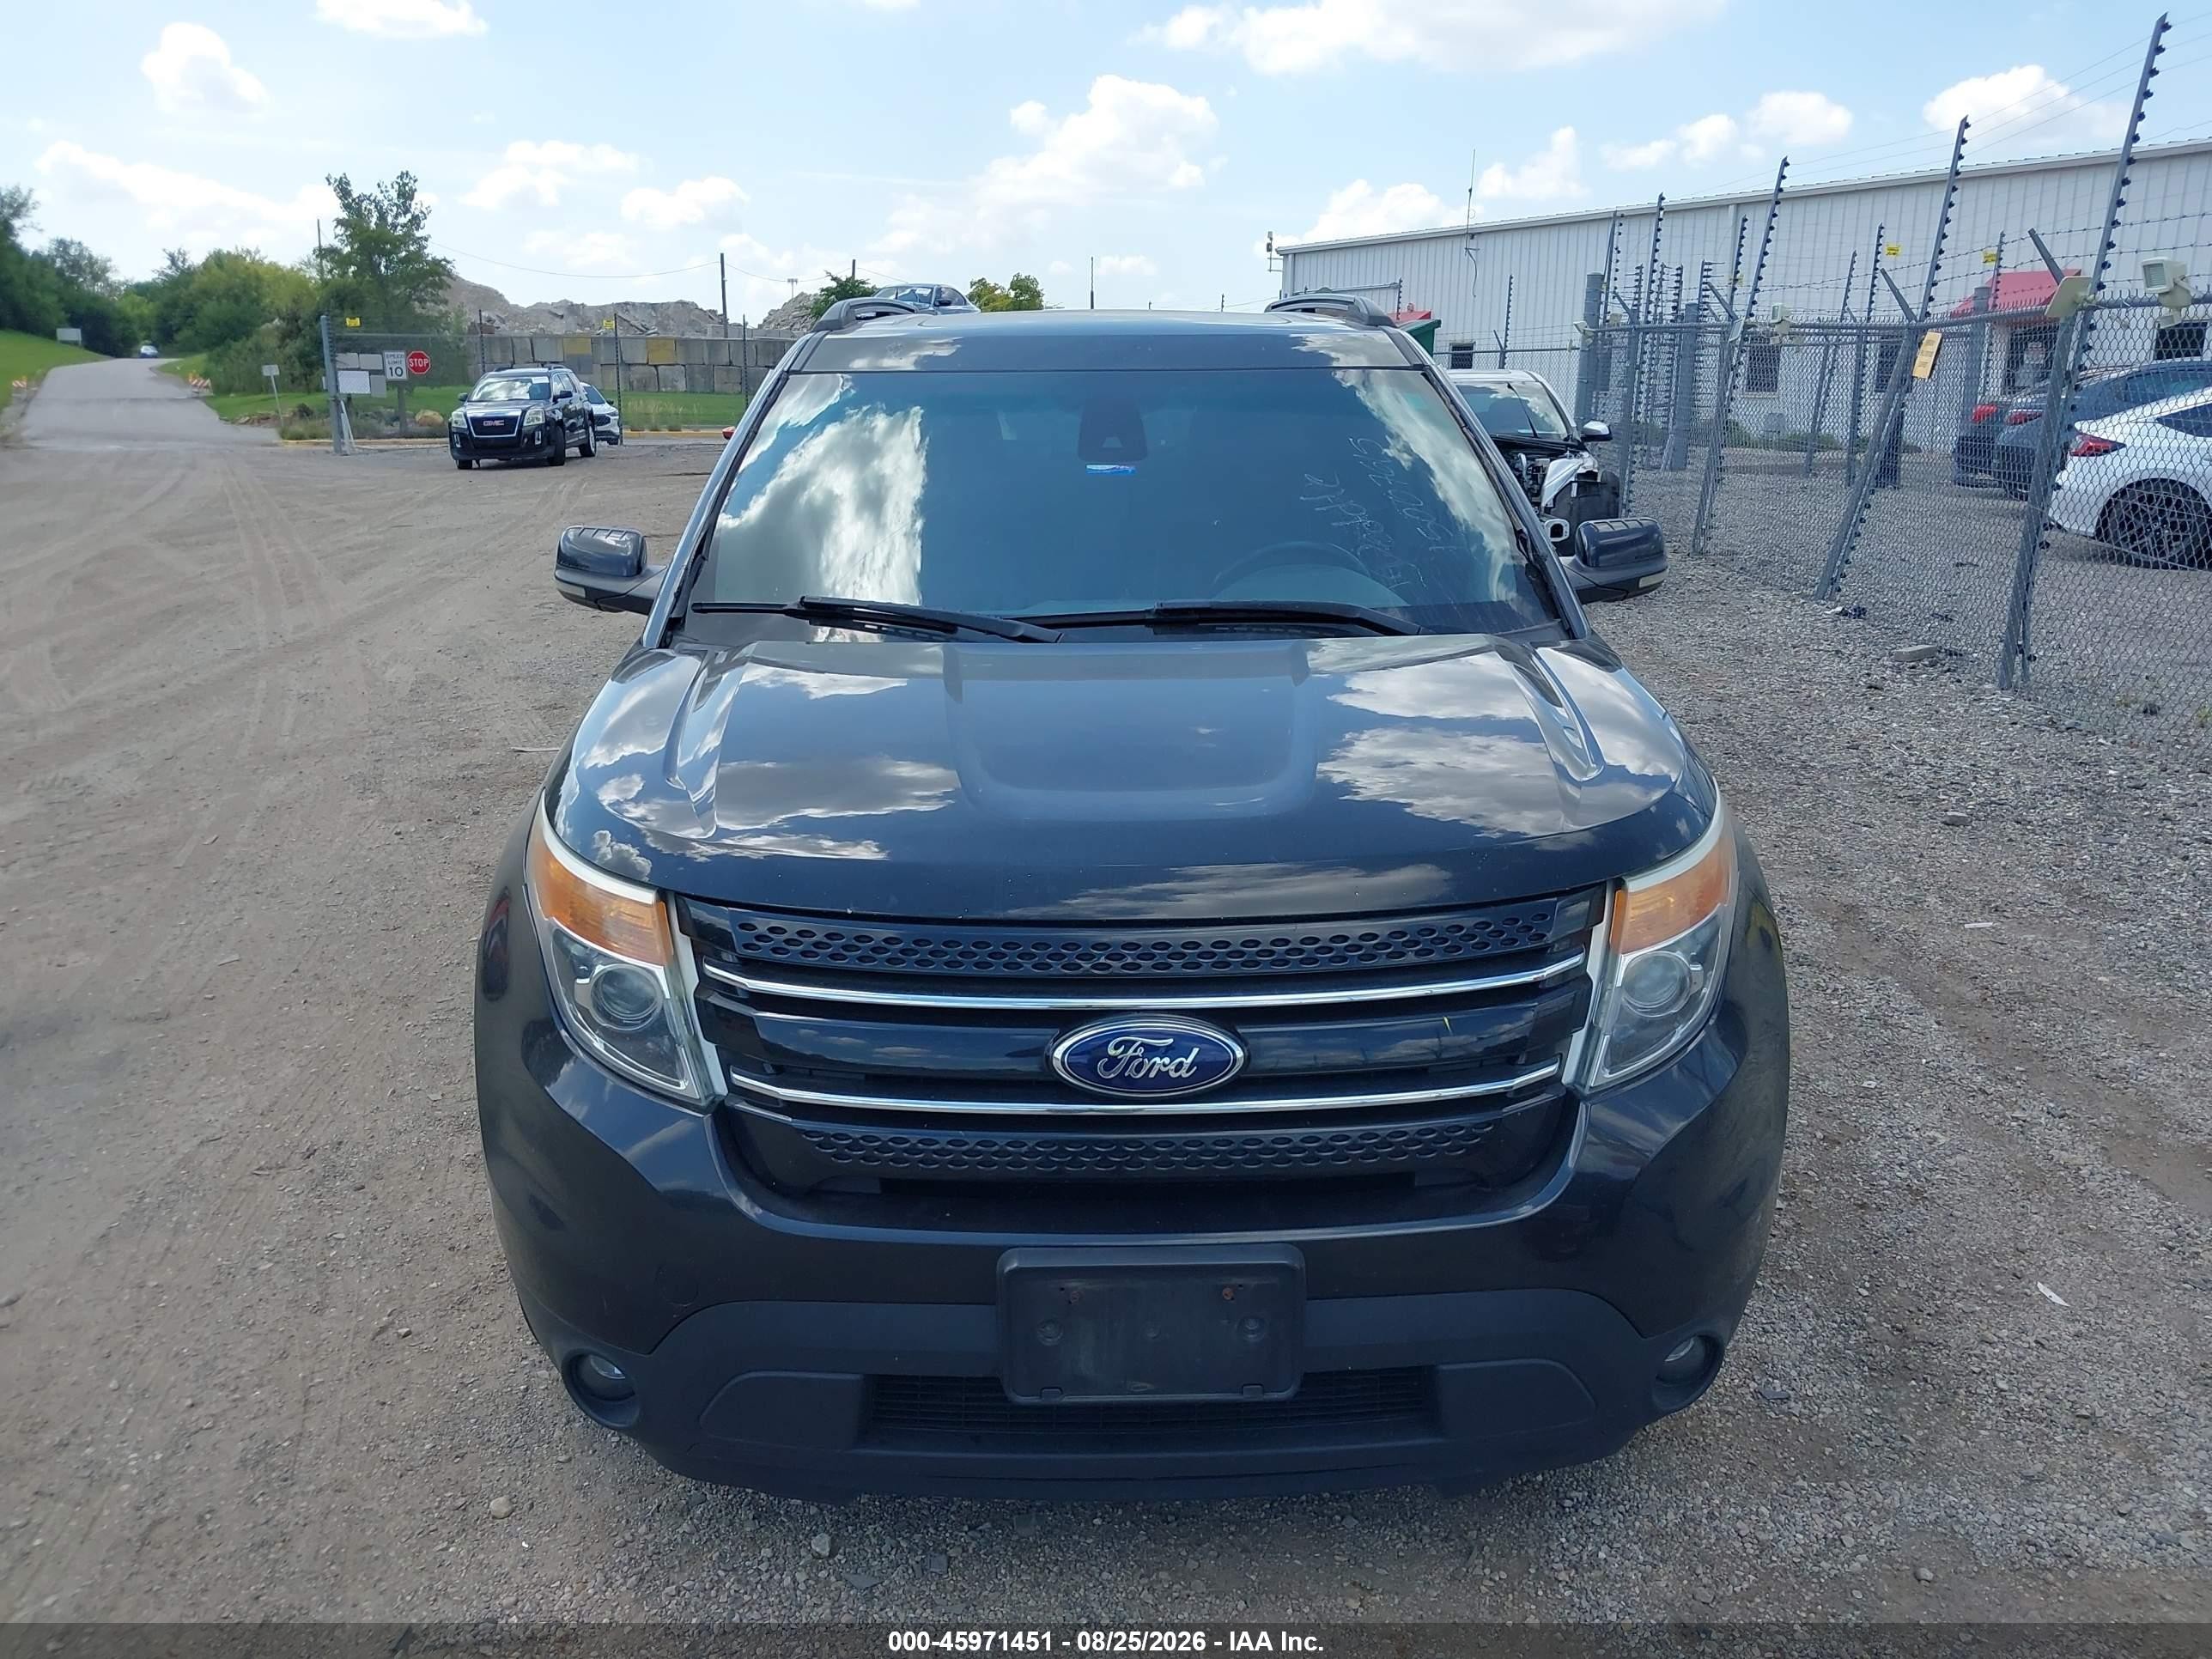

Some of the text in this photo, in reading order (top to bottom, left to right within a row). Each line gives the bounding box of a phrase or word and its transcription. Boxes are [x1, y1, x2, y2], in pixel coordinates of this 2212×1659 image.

[409, 358, 429, 368] STOP
[389, 366, 404, 377] 10
[1097, 1036, 1200, 1079] Ford
